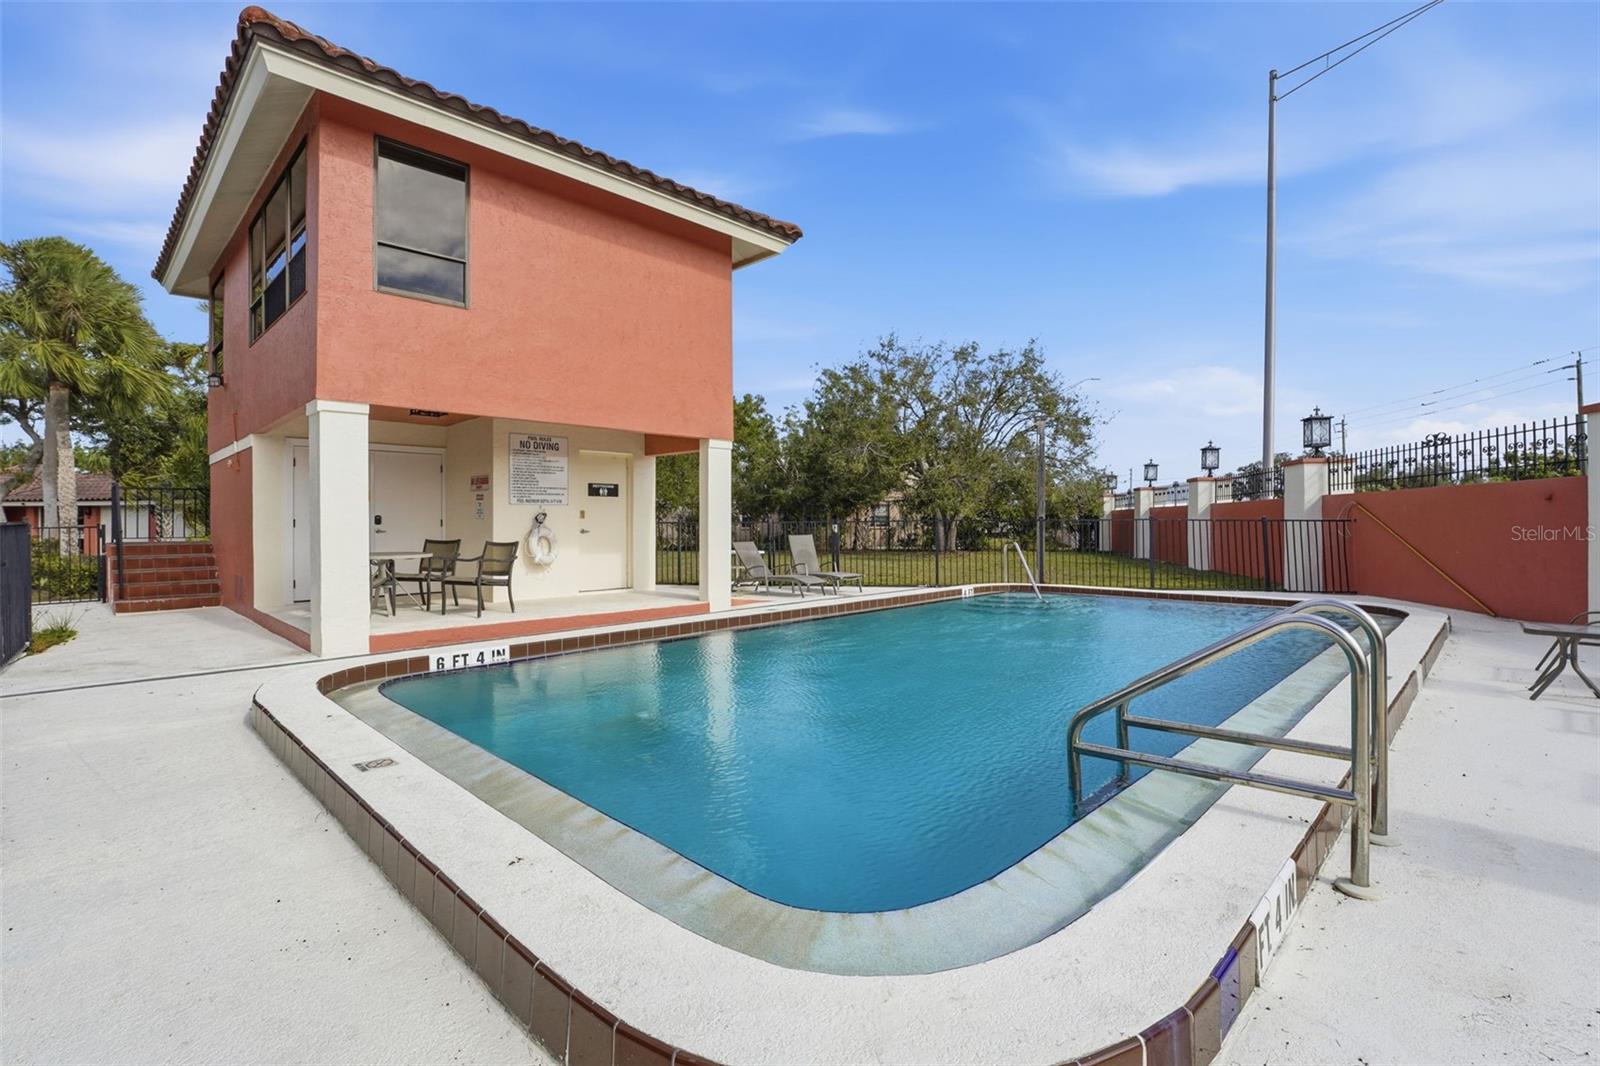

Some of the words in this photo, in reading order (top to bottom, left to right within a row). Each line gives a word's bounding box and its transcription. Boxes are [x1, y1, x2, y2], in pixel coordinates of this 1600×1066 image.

[519, 440, 531, 449] NO
[533, 441, 560, 451] DIVING
[437, 657, 445, 670] 6
[452, 653, 469, 668] FT
[476, 651, 486, 664] 4
[1258, 911, 1272, 970] FT
[1275, 894, 1282, 933] 4
[1285, 872, 1296, 920] IN
